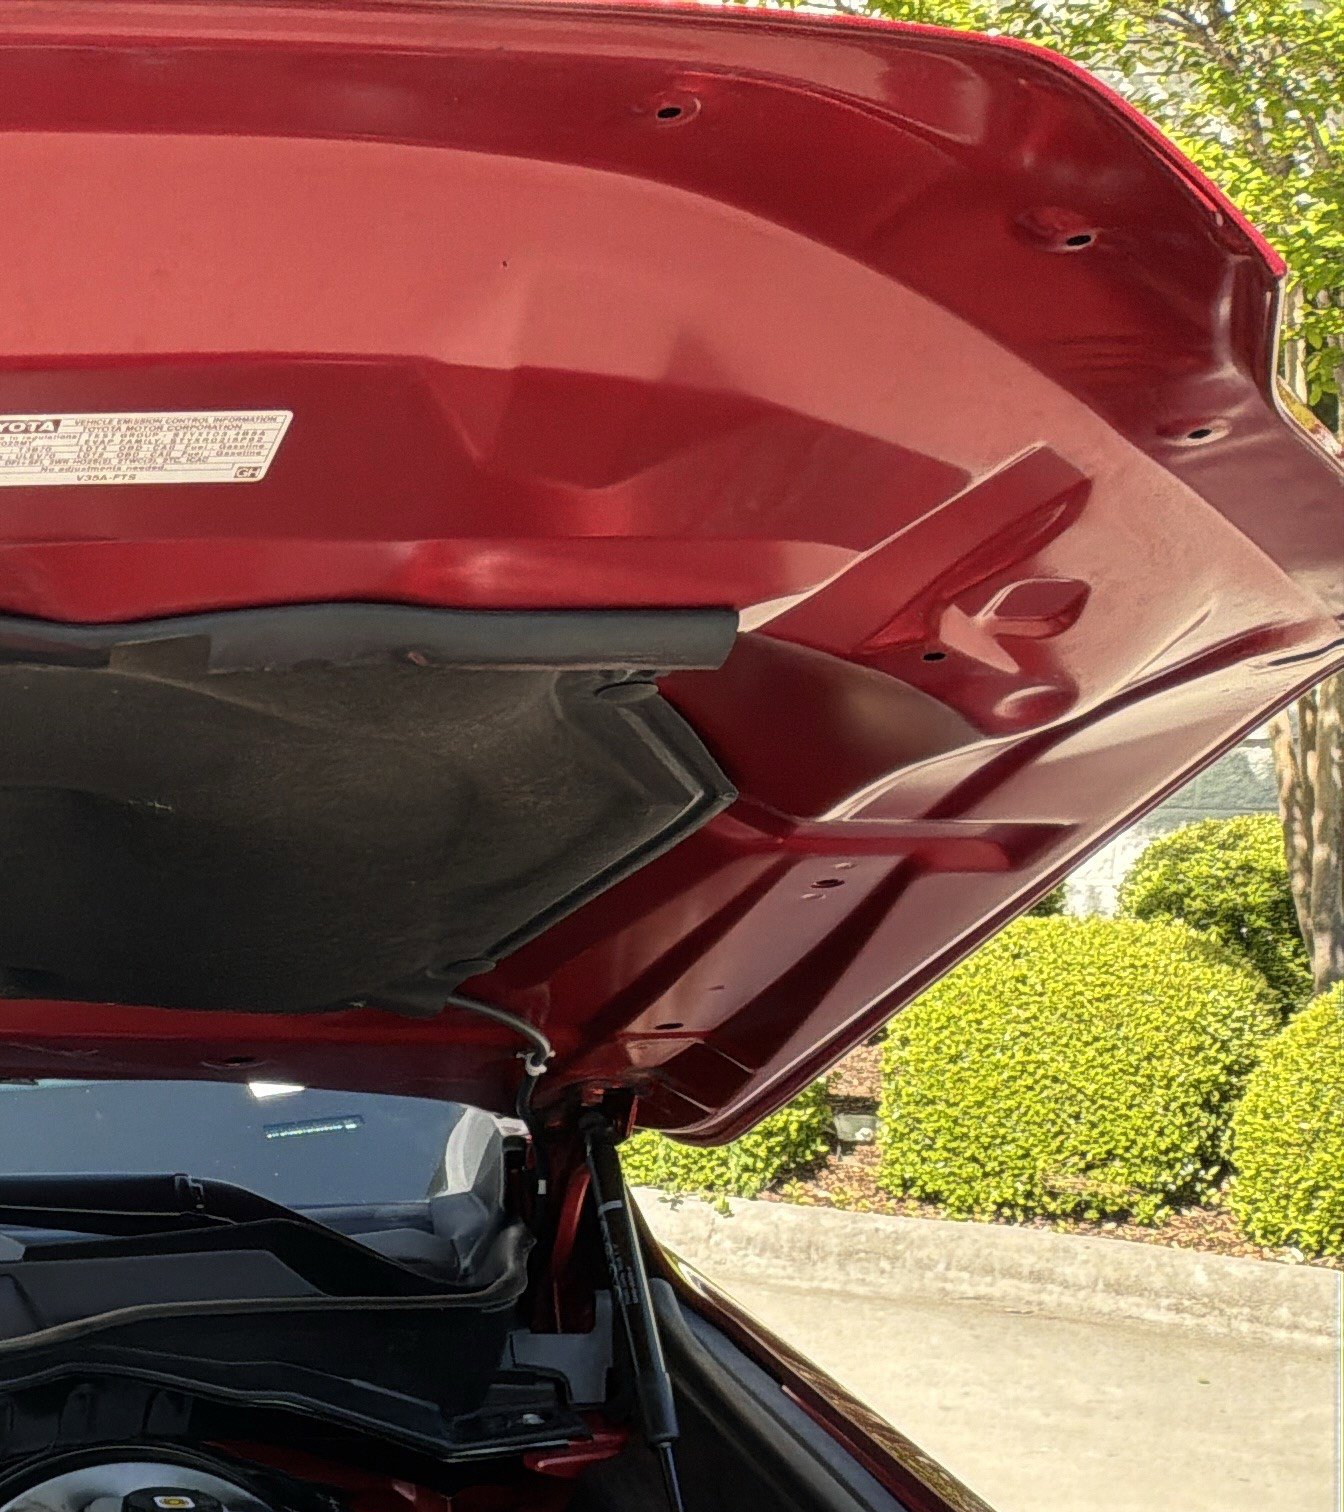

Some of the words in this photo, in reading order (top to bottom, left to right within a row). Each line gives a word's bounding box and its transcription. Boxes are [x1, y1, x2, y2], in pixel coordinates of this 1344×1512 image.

[75, 418, 113, 426] VEHICLE
[116, 417, 163, 425] EMISSION
[165, 416, 208, 424] CONTROL
[212, 414, 277, 423] INFORMATION
[22, 434, 78, 442] regulations
[58, 465, 121, 473] adjustments
[236, 467, 260, 478] GH
[76, 474, 137, 482] V35A-FTS
